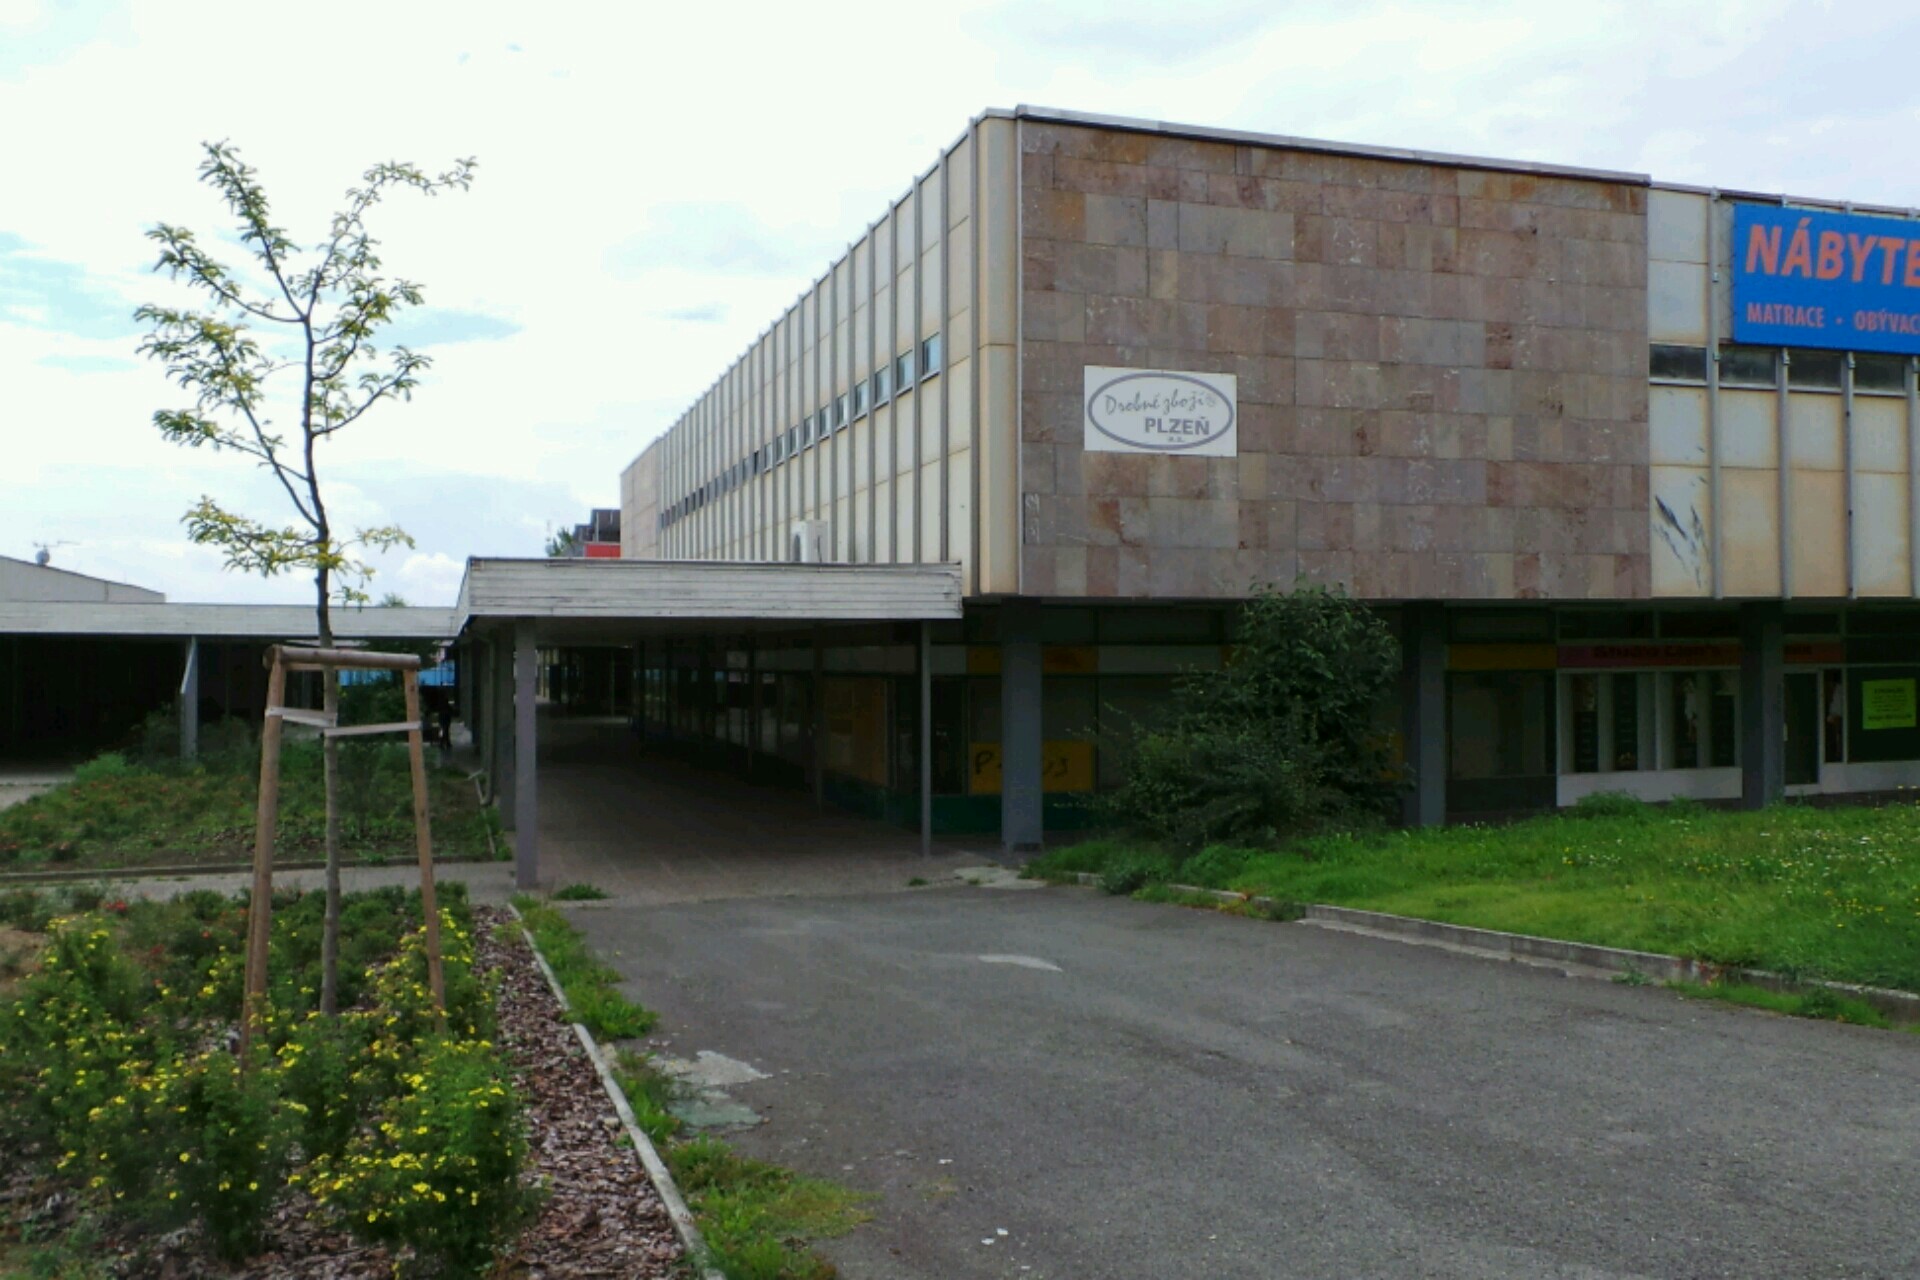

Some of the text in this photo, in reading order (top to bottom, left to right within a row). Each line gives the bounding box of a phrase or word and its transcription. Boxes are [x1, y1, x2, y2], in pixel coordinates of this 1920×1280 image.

[1747, 302, 1825, 328] MATRACE
[1105, 389, 1204, 415] Drobné zboží
[1145, 416, 1209, 435] PLZEŇ
